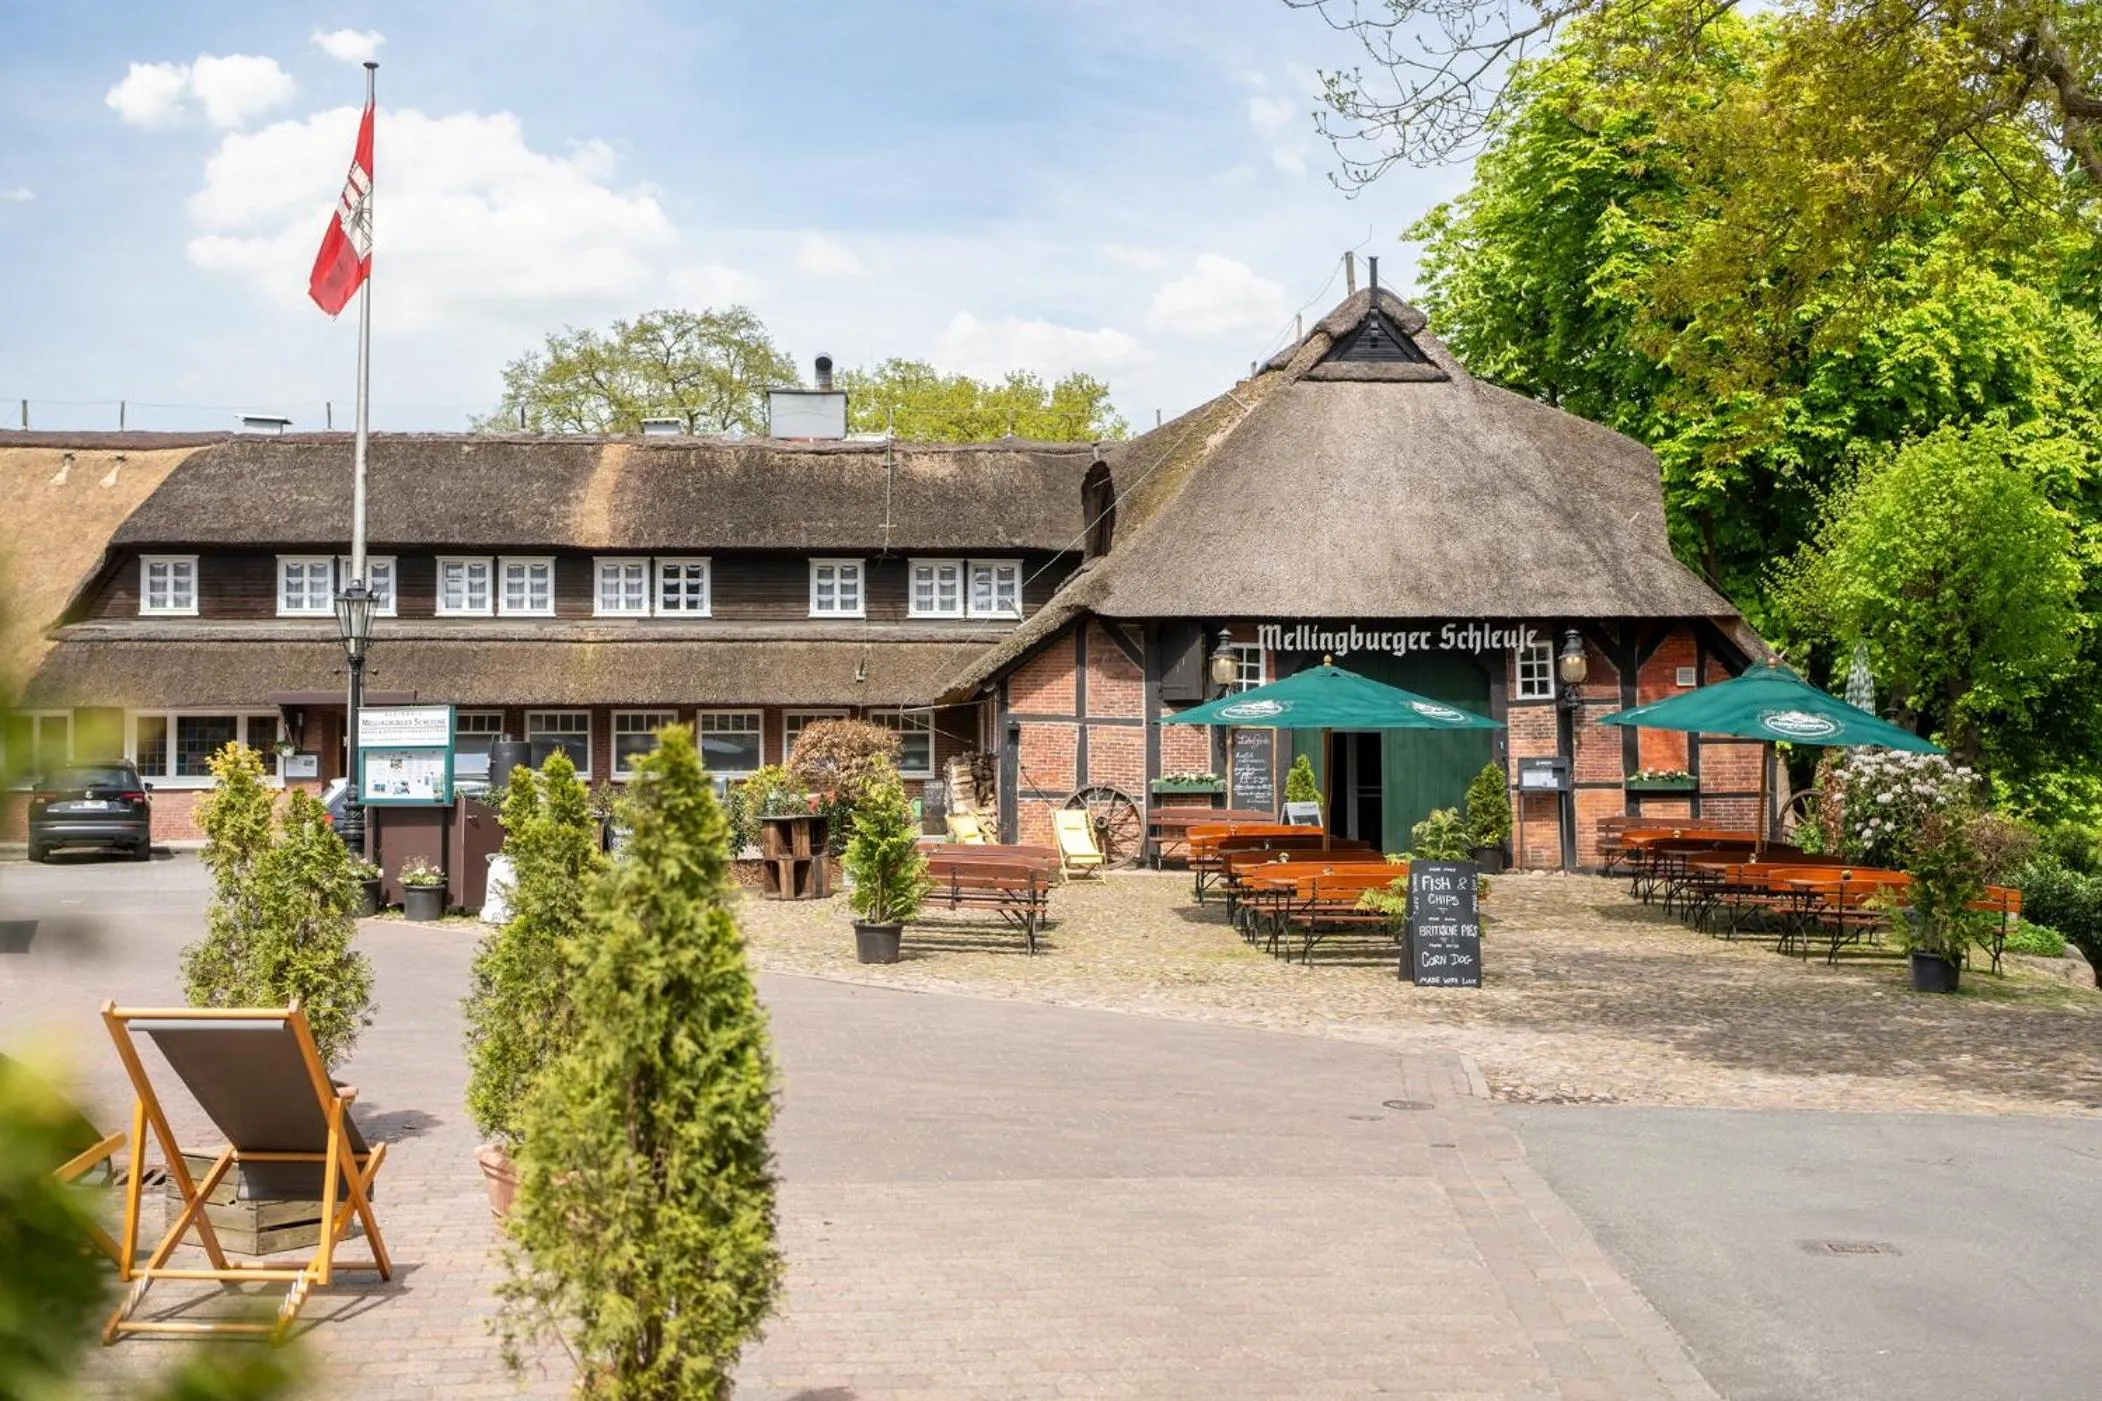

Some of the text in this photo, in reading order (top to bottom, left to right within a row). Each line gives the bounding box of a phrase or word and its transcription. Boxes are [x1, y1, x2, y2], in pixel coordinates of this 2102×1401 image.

[1257, 624, 1432, 657] Mellingburger
[1421, 875, 1468, 891] FISH &
[1427, 893, 1460, 906] CHIPS
[1421, 951, 1473, 968] CORN DOG
